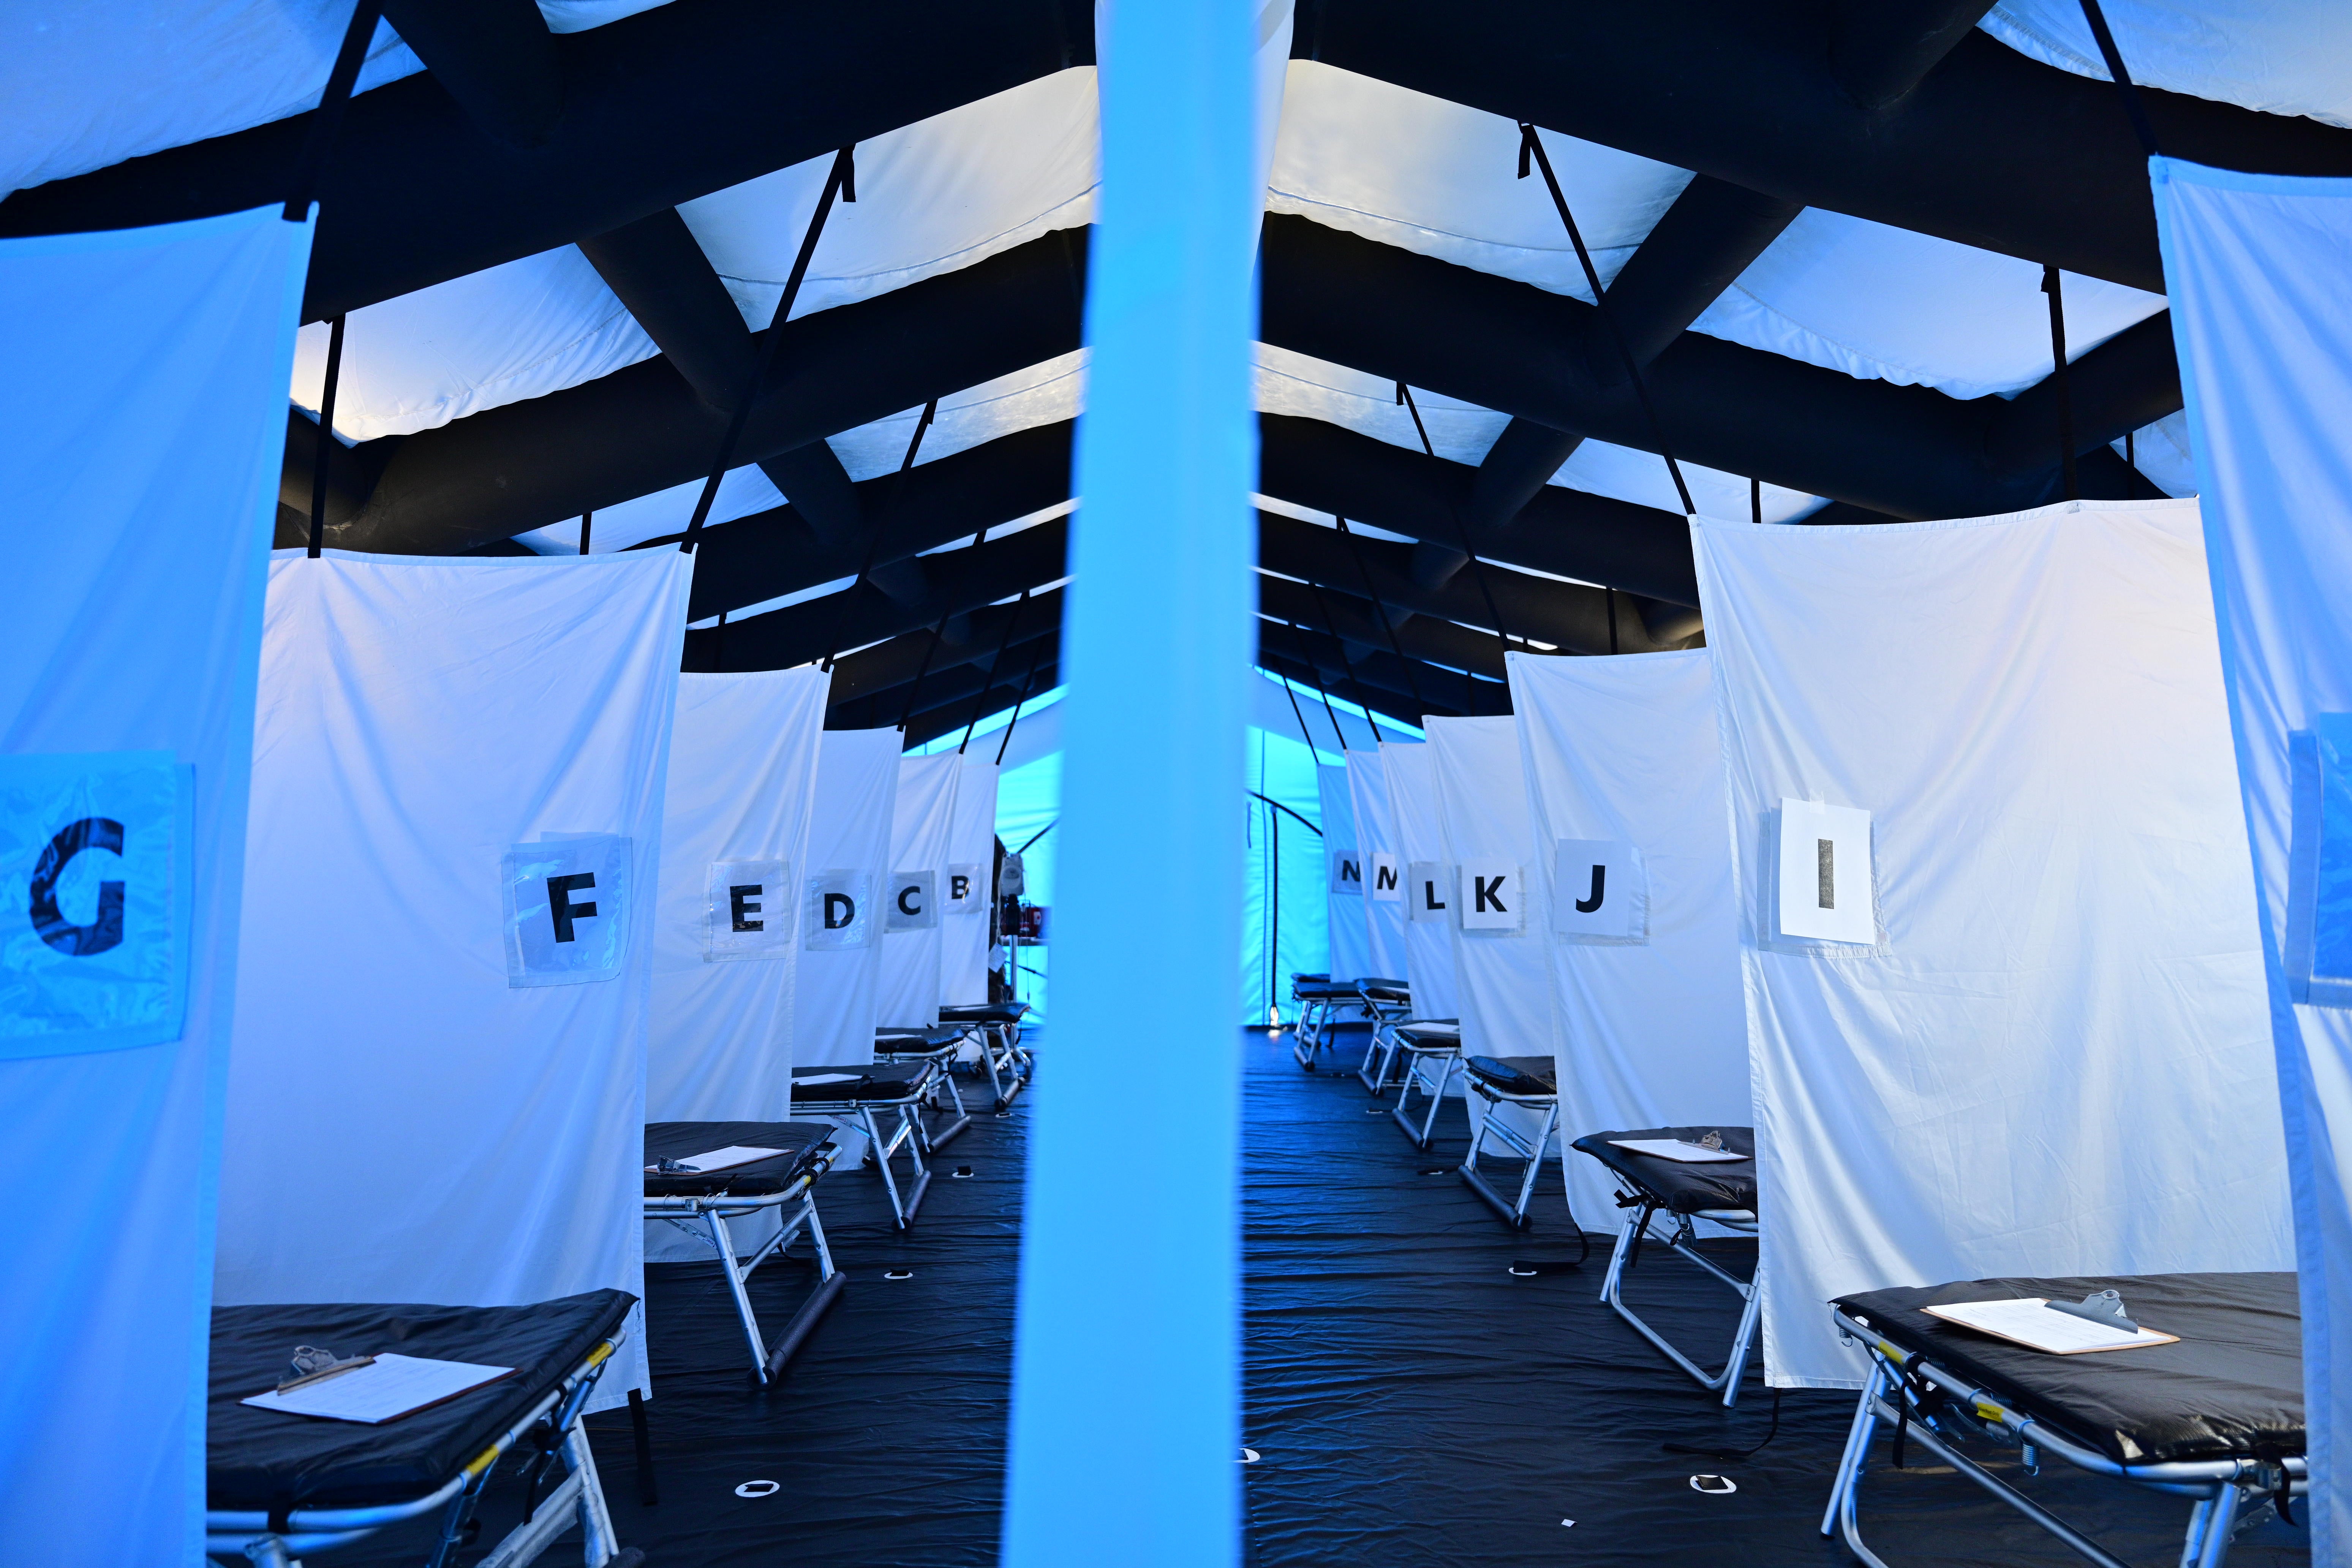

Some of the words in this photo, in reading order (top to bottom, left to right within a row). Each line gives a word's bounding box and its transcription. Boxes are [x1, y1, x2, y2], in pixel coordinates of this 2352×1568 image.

[30, 817, 125, 956] G
[951, 875, 970, 900] B
[1342, 860, 1360, 882] N
[1576, 865, 1606, 913] J
[1818, 838, 1835, 910] I
[547, 872, 597, 943] F
[730, 884, 764, 932] E
[824, 893, 855, 929] D
[898, 886, 921, 915] C
[1425, 880, 1446, 910] L
[1475, 876, 1508, 912] K
